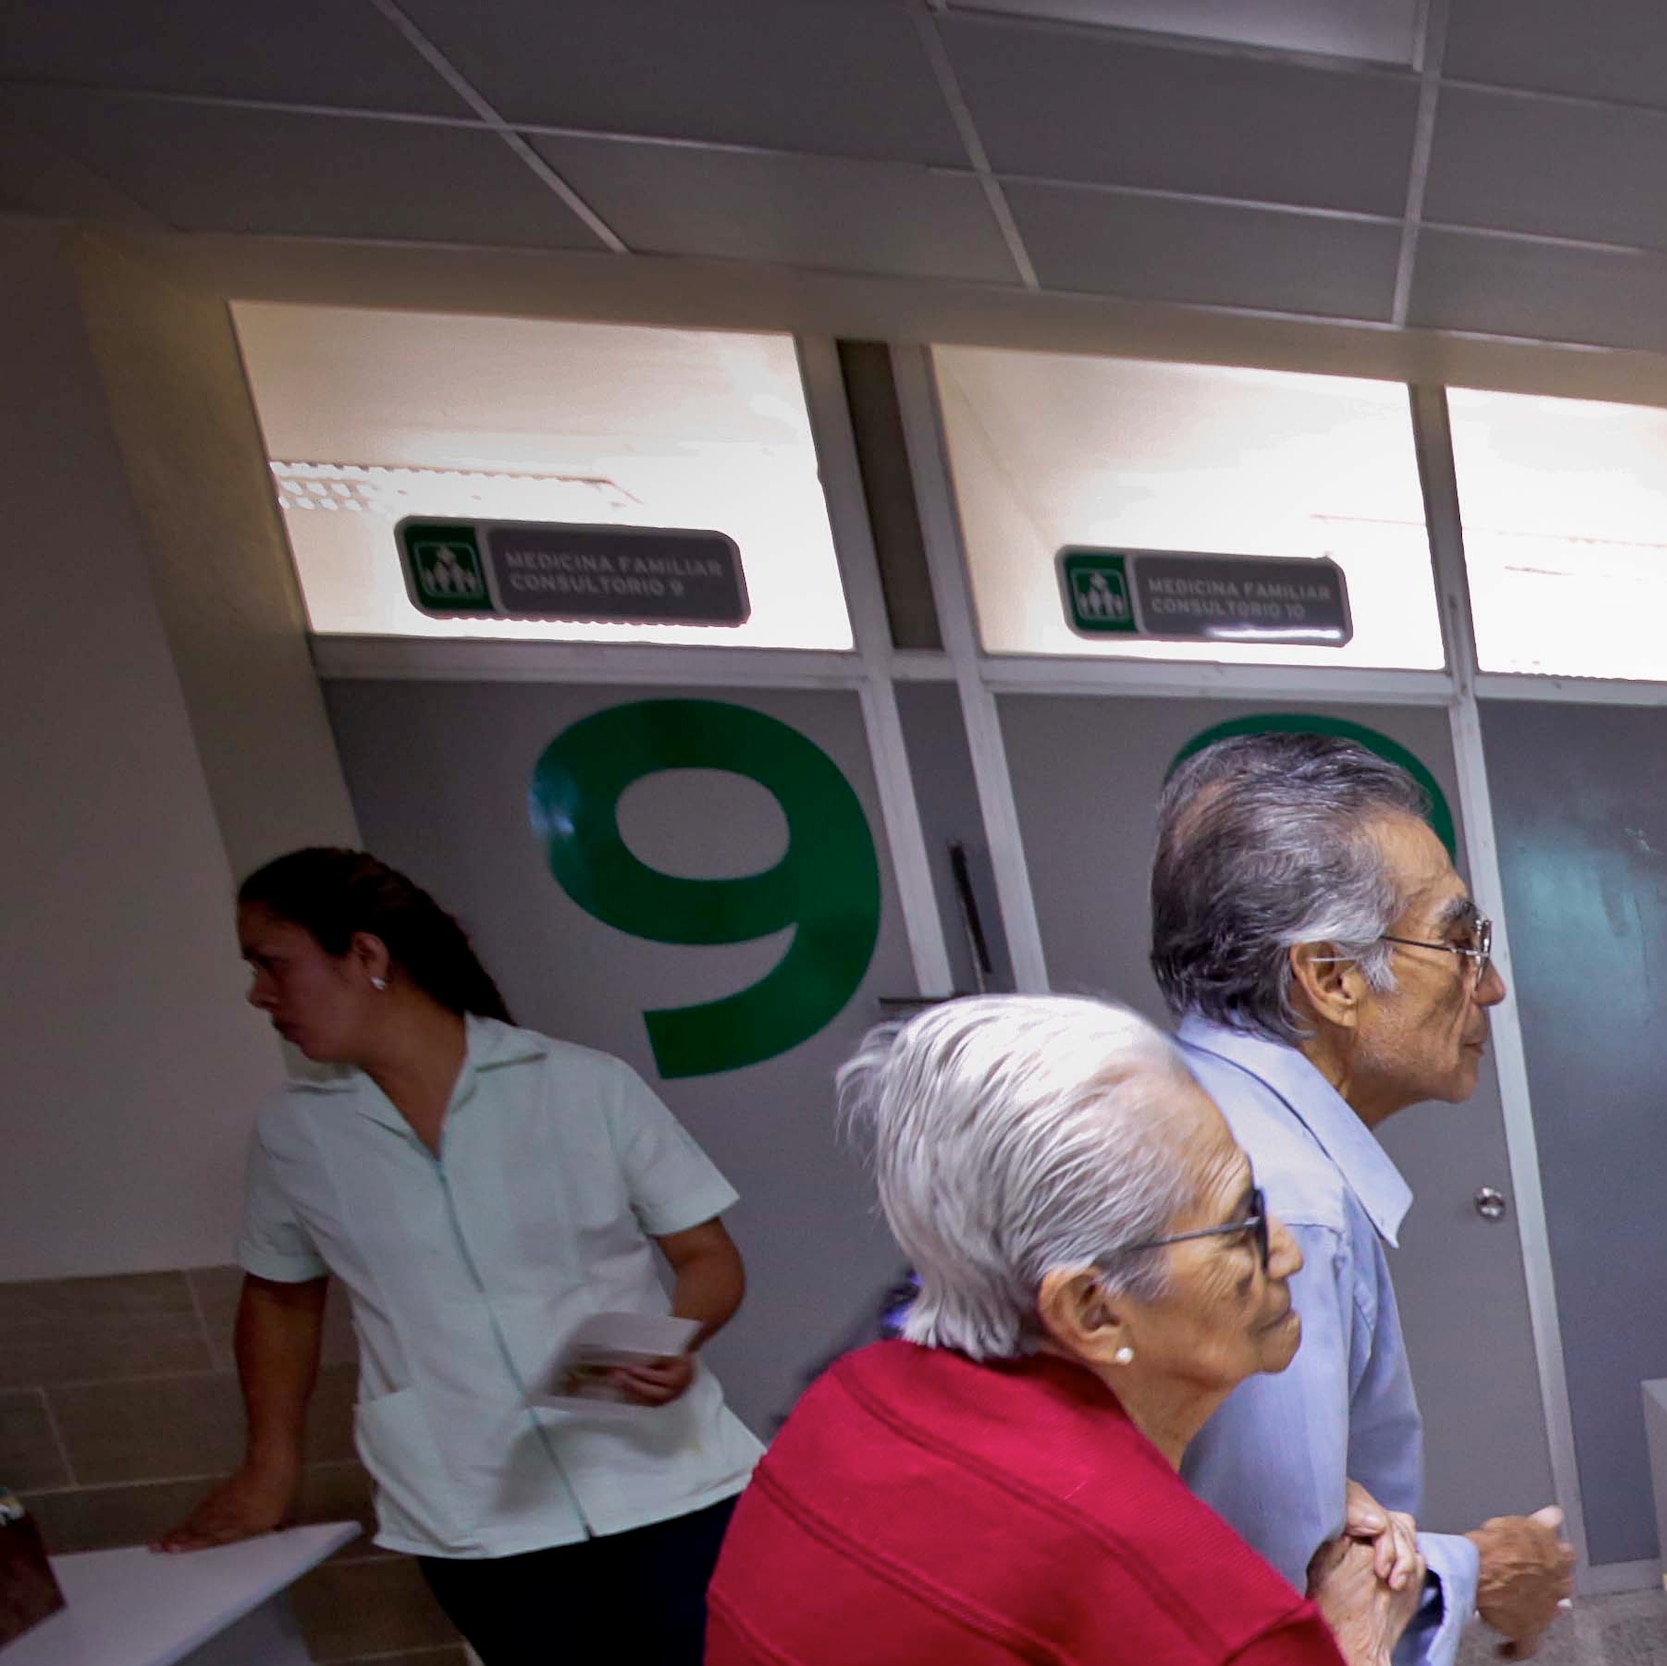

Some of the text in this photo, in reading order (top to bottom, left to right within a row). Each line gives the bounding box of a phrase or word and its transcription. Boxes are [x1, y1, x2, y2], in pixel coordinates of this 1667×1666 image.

[505, 551, 723, 577] MEDICINA FAMILIAR
[511, 573, 664, 595] CONSULTORIO
[1149, 577, 1331, 600] MEDICINA FAMILIAR
[1152, 597, 1306, 619] CONSULTORIO 10
[531, 697, 882, 1080] 9
